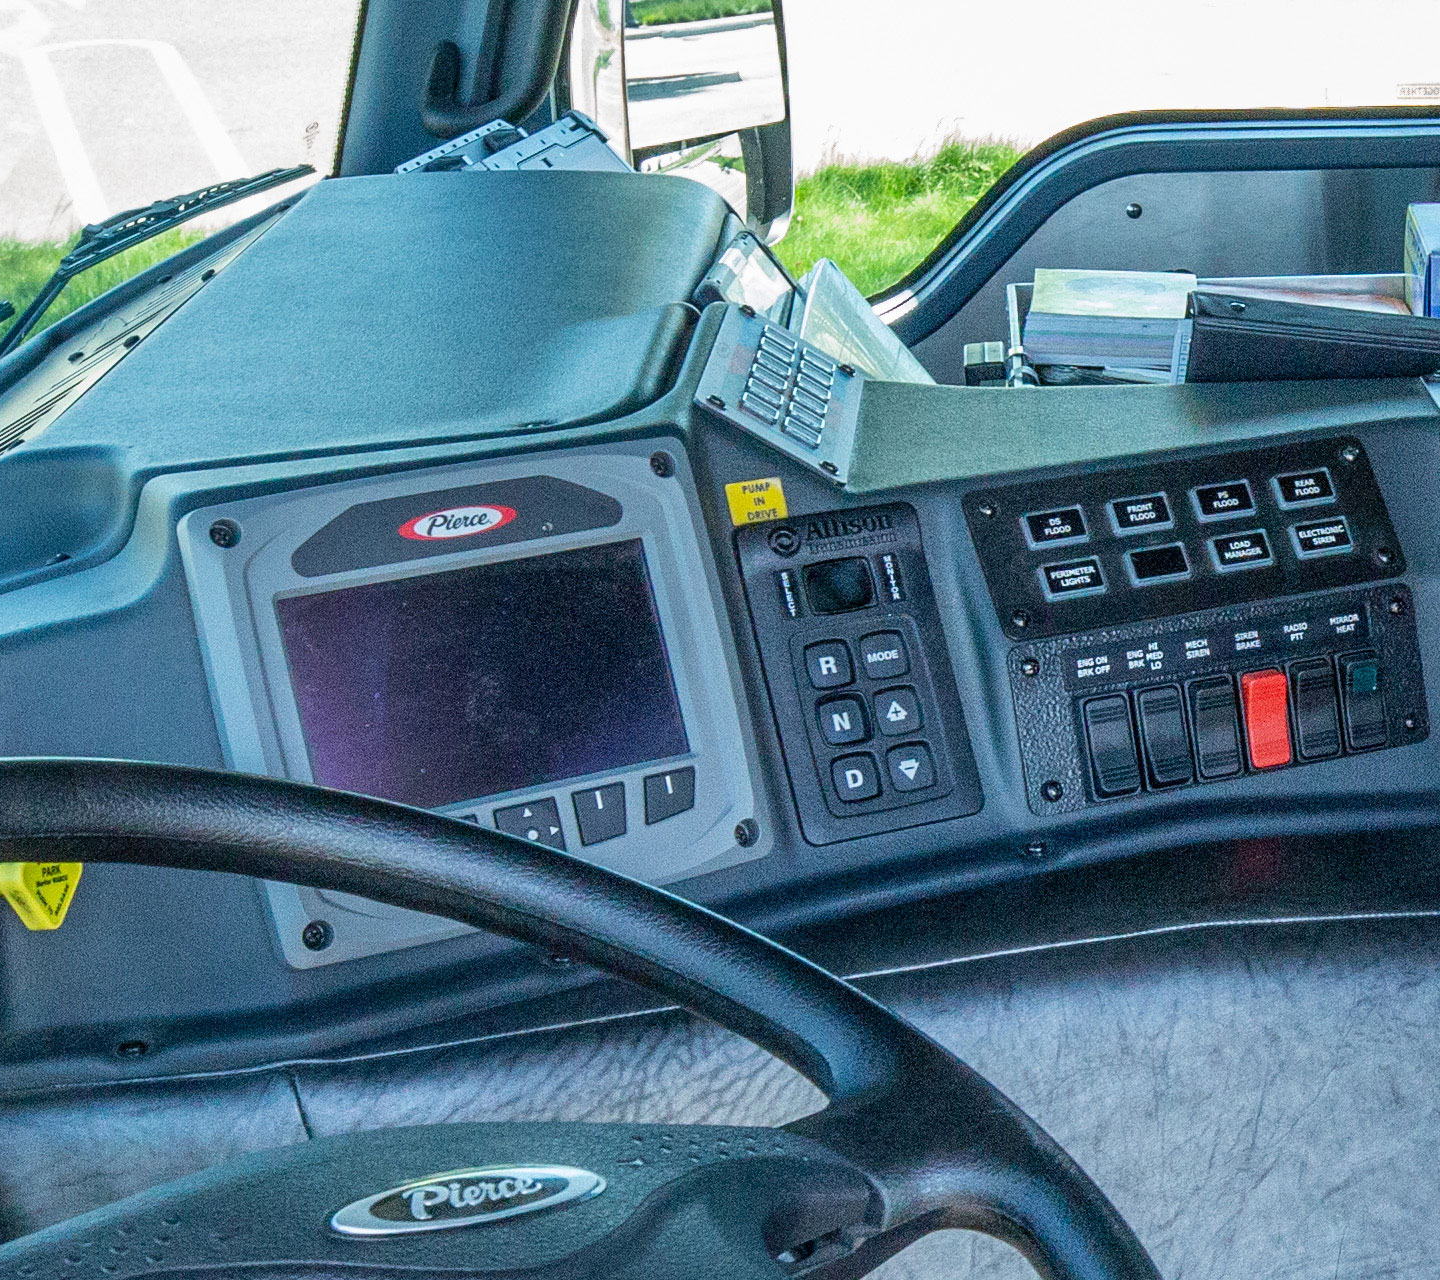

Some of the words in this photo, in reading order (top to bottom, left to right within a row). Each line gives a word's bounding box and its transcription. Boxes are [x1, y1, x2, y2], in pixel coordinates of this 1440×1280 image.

[741, 482, 770, 494] PUMP
[1294, 478, 1315, 488] REAR
[1294, 486, 1320, 496] FLOOD
[753, 497, 766, 506] IN
[1213, 497, 1239, 508] FLOOD
[1126, 502, 1153, 514] FRONT
[747, 508, 778, 521] DRIVE
[1130, 510, 1156, 521] FLOOD
[428, 513, 488, 536] Pierce
[1045, 524, 1071, 536] FLOOD
[1298, 524, 1344, 539] ELECTRONIC
[1229, 539, 1251, 550] LOAD
[1312, 534, 1336, 545] SIREN
[1224, 547, 1262, 559] MANAGER
[883, 554, 900, 600] MONITOR
[1050, 566, 1096, 580] PERIMETER
[1061, 575, 1091, 587] LIGHTS
[781, 572, 796, 617] SELECT
[1329, 613, 1359, 625] MIRROR
[1283, 622, 1308, 634] RADIO
[1336, 623, 1355, 634] HEAT
[1234, 630, 1258, 642] SIREN
[1185, 639, 1208, 649] MECH
[1236, 640, 1261, 650] BRAKE
[867, 649, 899, 663] MODE
[1126, 649, 1143, 660] ENG
[1186, 648, 1210, 659] SIREN
[819, 656, 837, 675] R
[1077, 658, 1093, 668] ENG
[1095, 655, 1108, 665] ON
[1077, 667, 1093, 678] BRK
[1094, 665, 1110, 675] OFF
[832, 712, 851, 731] N
[845, 769, 864, 788] D
[42, 865, 61, 877] PARK
[402, 1176, 541, 1220] Pierce
